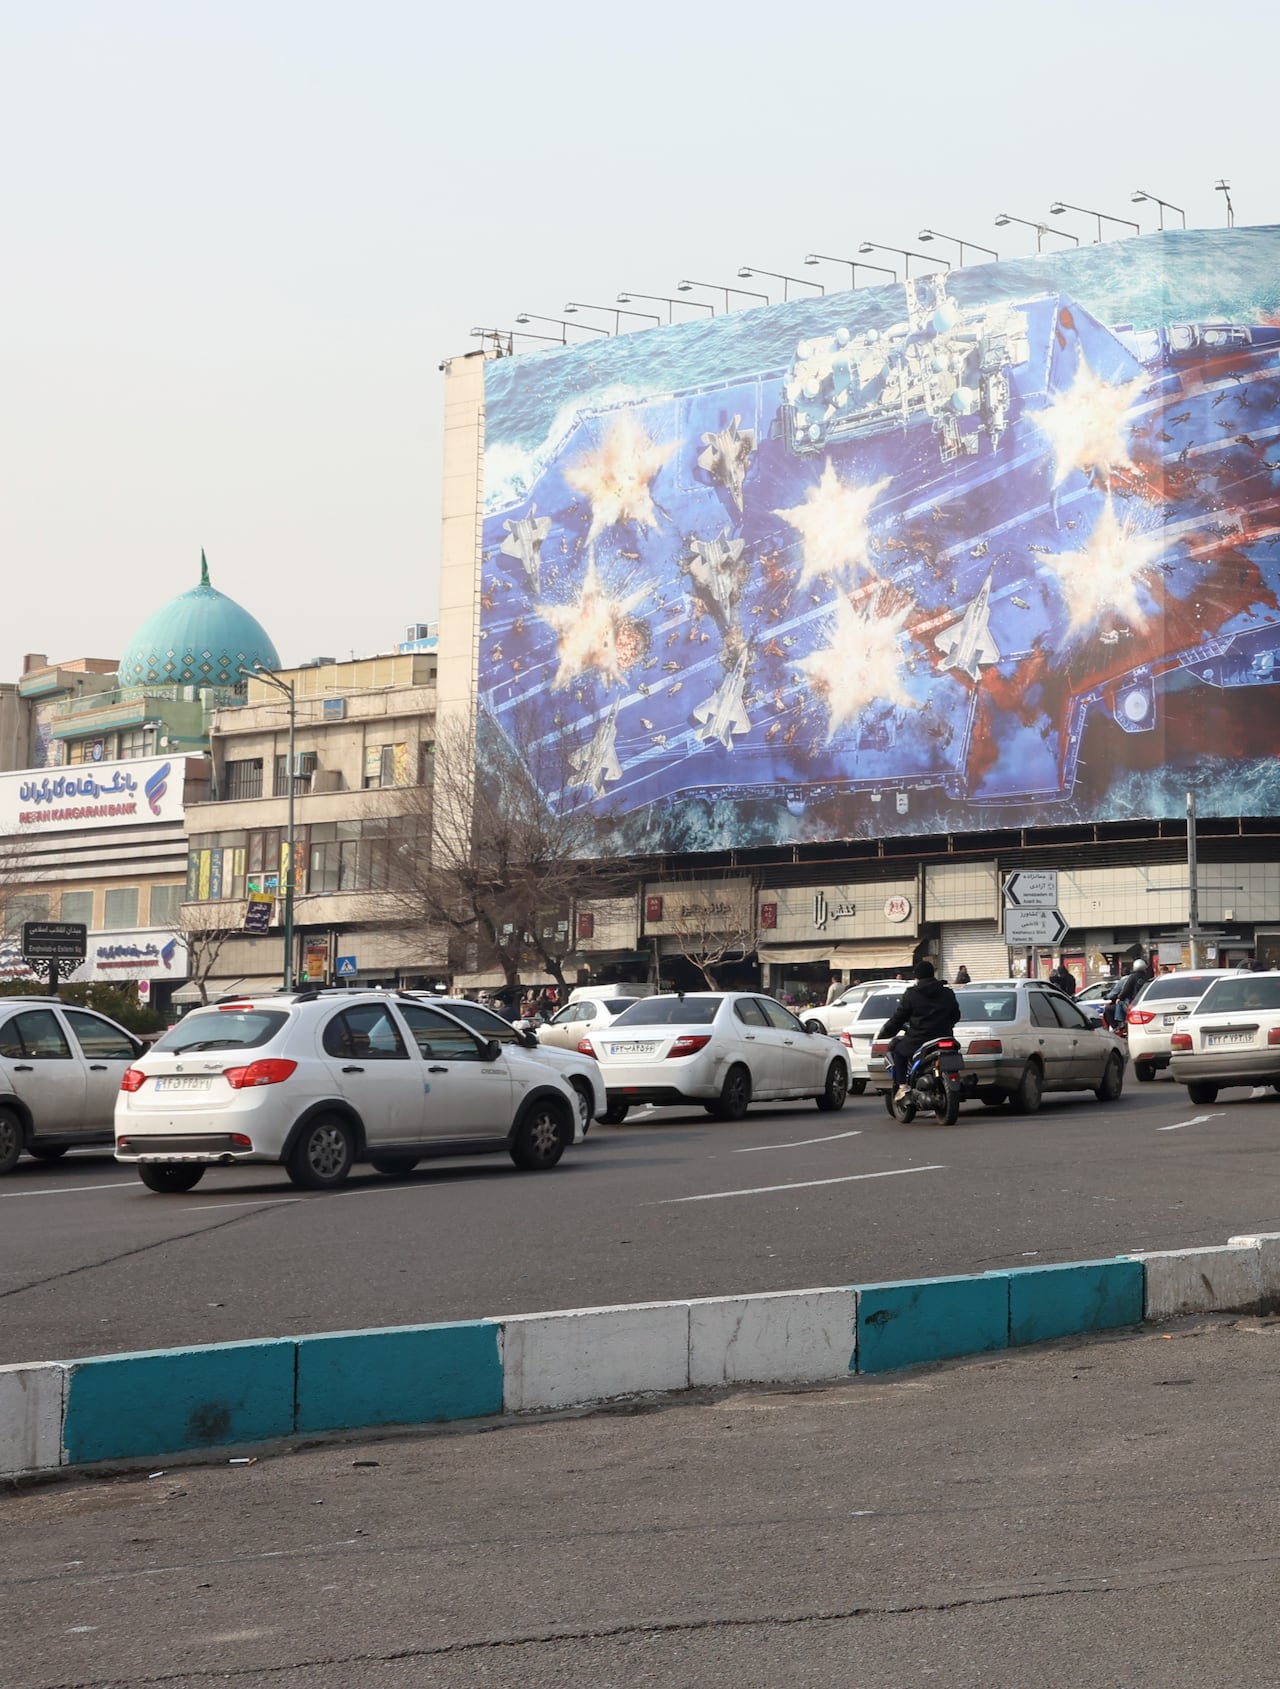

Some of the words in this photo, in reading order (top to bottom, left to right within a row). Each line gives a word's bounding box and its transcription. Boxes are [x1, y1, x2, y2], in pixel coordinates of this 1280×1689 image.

[19, 776, 66, 805] کارگران
[65, 773, 100, 799] رفاه
[100, 770, 138, 798] بانک
[19, 810, 50, 825] REFAH
[51, 804, 109, 821] KARGARAN
[109, 802, 138, 816] BANK
[830, 903, 856, 921] کفش
